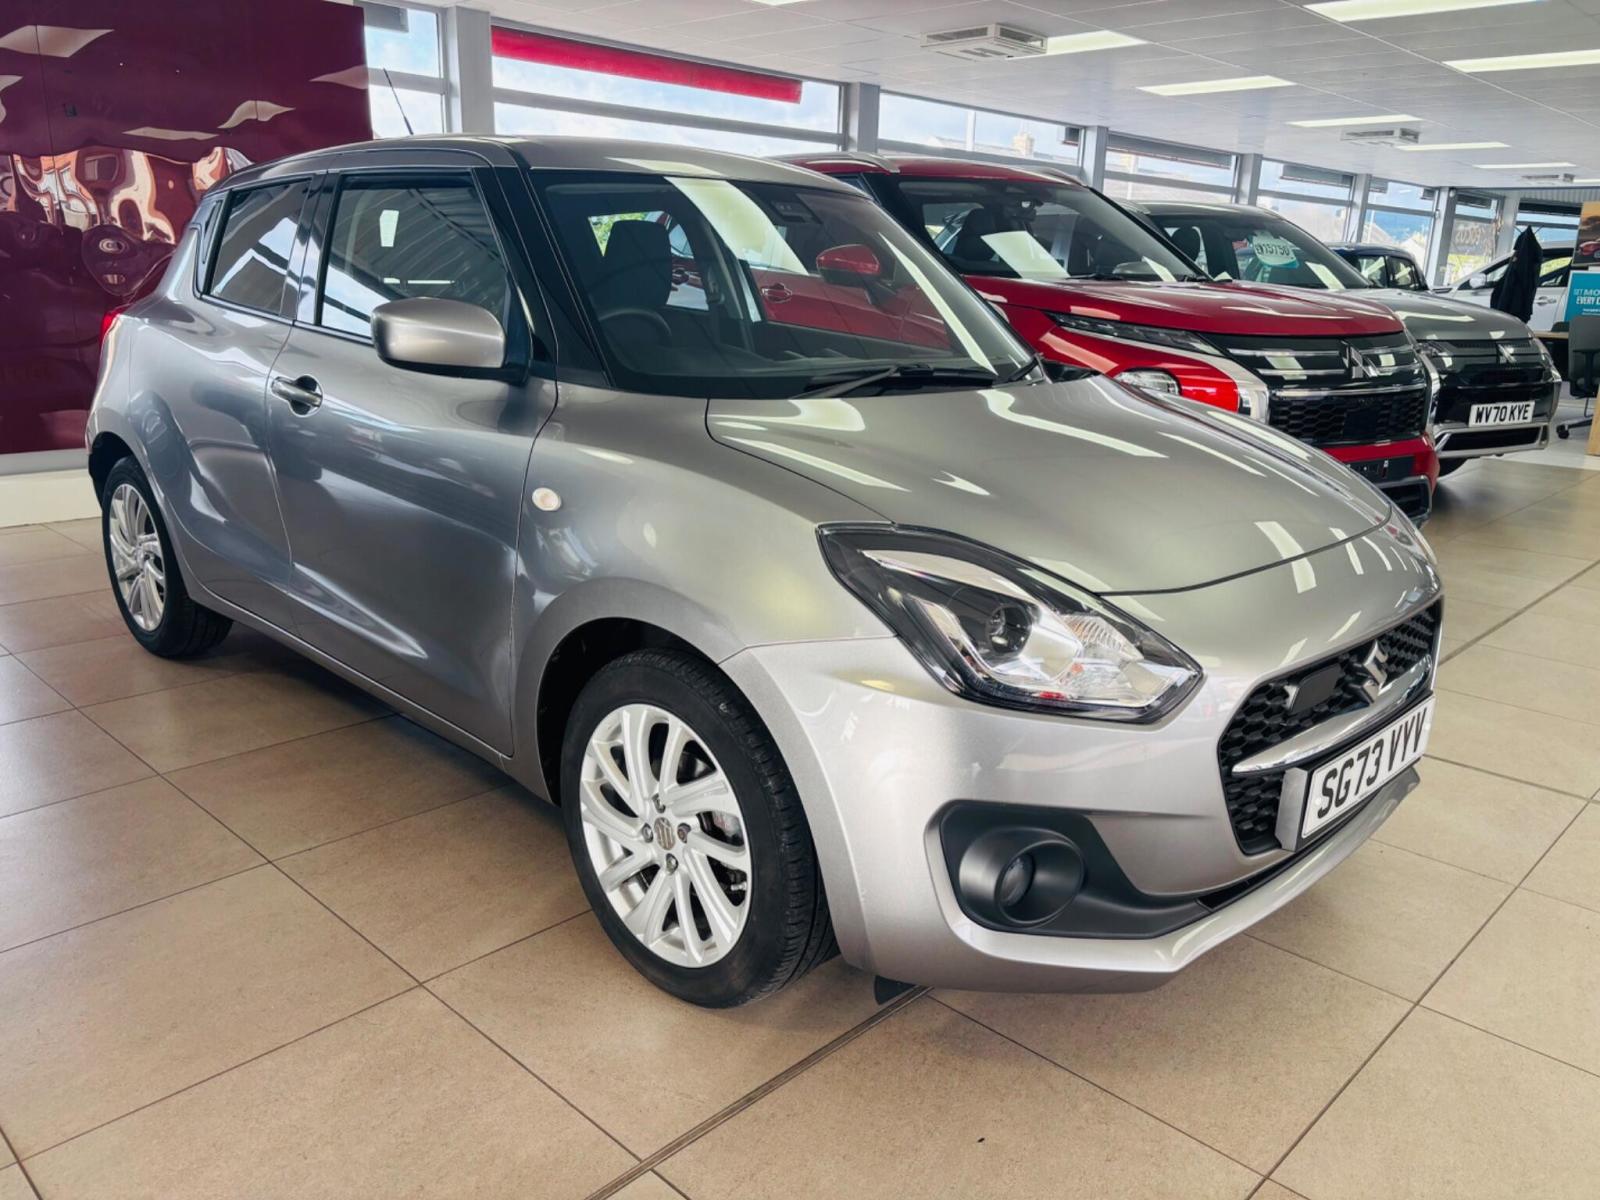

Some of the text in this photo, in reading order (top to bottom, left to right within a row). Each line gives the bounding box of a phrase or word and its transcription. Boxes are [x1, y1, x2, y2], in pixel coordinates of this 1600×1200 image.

[1475, 404, 1531, 423] WV70 KYE
[1317, 707, 1427, 819] SG73 VYV
